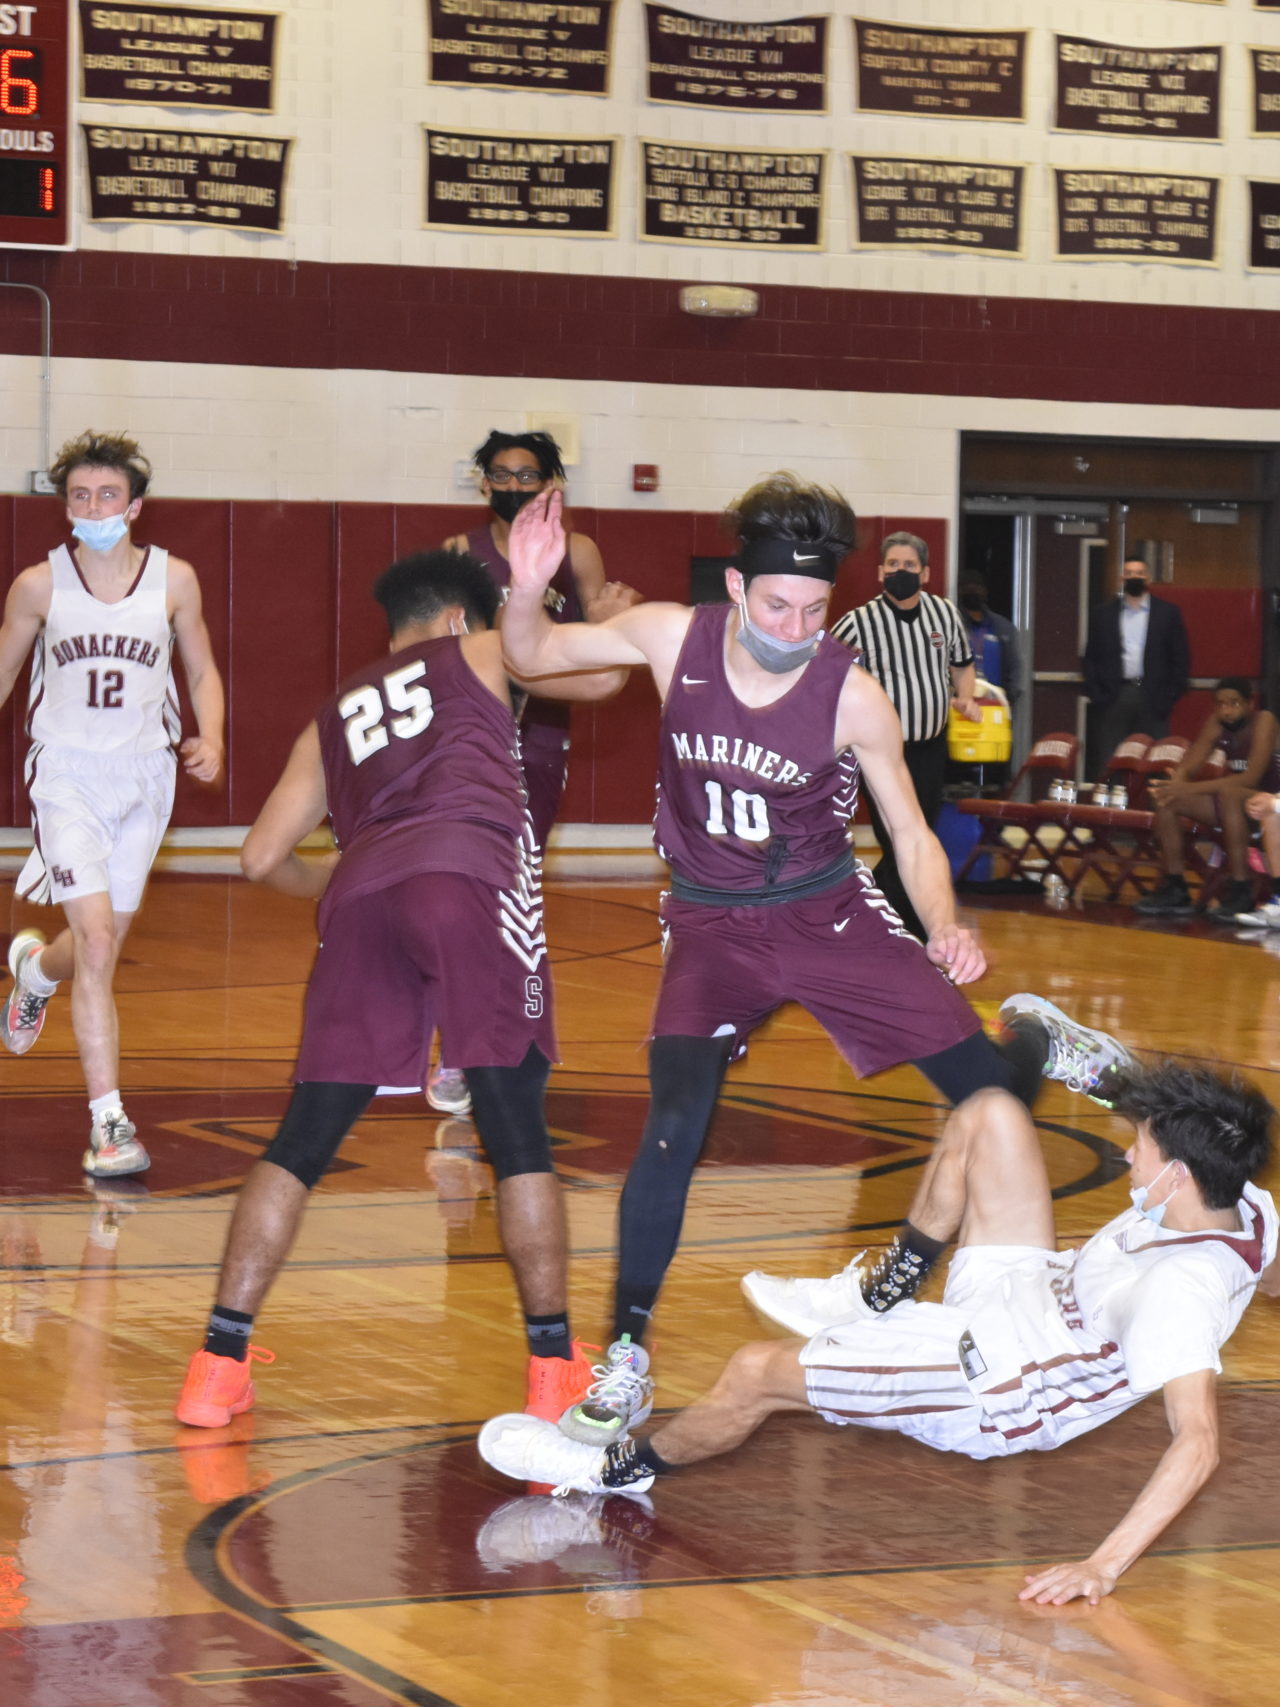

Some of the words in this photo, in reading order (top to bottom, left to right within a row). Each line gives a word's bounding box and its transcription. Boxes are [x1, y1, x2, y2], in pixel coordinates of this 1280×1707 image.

[90, 9, 265, 41] SOUTHAMPTON
[440, 0, 600, 25] SOUTHAMPTON
[467, 24, 547, 40] LEAGUE
[658, 15, 816, 43] SOUTHAMPTON
[863, 29, 1017, 57] SOUTHAMPTON
[120, 39, 209, 55] LEAGUE
[213, 46, 233, 57] V
[431, 39, 519, 60] BASKETBALL
[688, 45, 756, 63] LEAGUE
[1060, 43, 1218, 72] SOUTHAMPTON
[83, 54, 185, 74] BASKETBALL
[186, 61, 272, 80] CHAMPIONS
[90, 129, 283, 161] SOUTHAMPTON
[431, 136, 609, 164] SOUTHAMPTON
[129, 156, 199, 173] LEAGUE
[467, 163, 531, 181] LEAGUE
[647, 145, 819, 174] SOUTHAMPTON
[863, 161, 1014, 187] SOUTHAMPTON
[1063, 173, 1211, 199] SOUTHAMPTON
[96, 176, 188, 198] BASKETBALL
[196, 181, 275, 206] CHAMPIONS
[435, 181, 521, 204] BASKETBALL
[529, 187, 603, 207] CHAMPIONS
[660, 202, 805, 229] BASKETBALL
[86, 668, 125, 708] 12
[338, 659, 435, 768] 25
[671, 732, 814, 787] MARINERS
[704, 779, 771, 842] 10
[525, 975, 543, 1019] S
